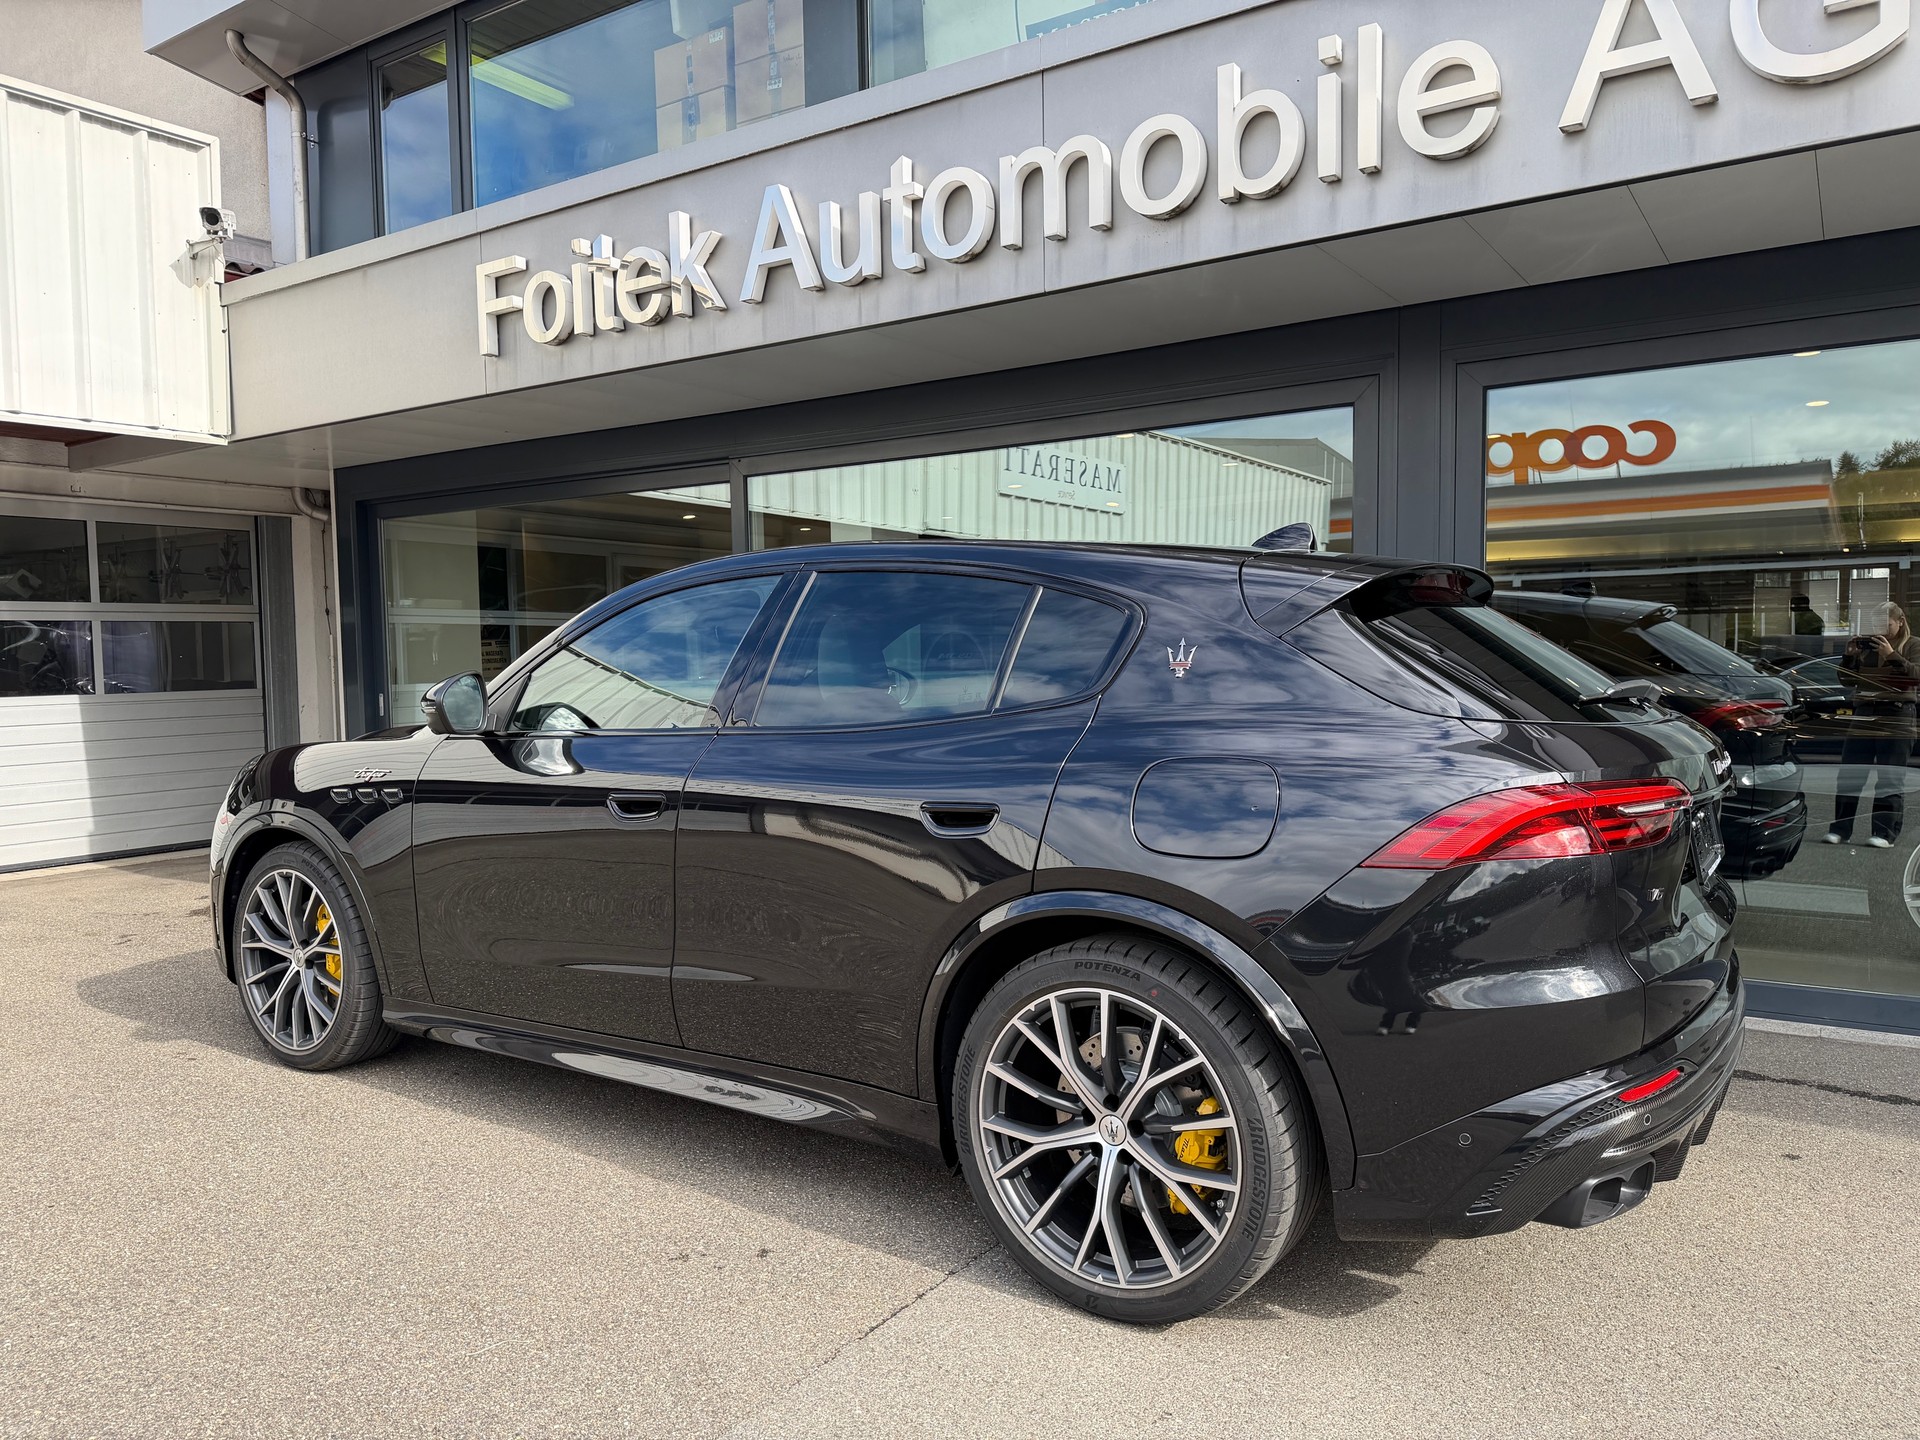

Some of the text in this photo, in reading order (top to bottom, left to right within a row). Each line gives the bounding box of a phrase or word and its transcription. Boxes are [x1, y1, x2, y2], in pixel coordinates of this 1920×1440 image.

[475, 210, 728, 358] Foitek
[740, 22, 1502, 304] Automobile
[1073, 961, 1141, 982] POTENZA
[958, 1043, 977, 1156] BRIDGESTONE
[1242, 1117, 1267, 1243] BRIDGESTONE
